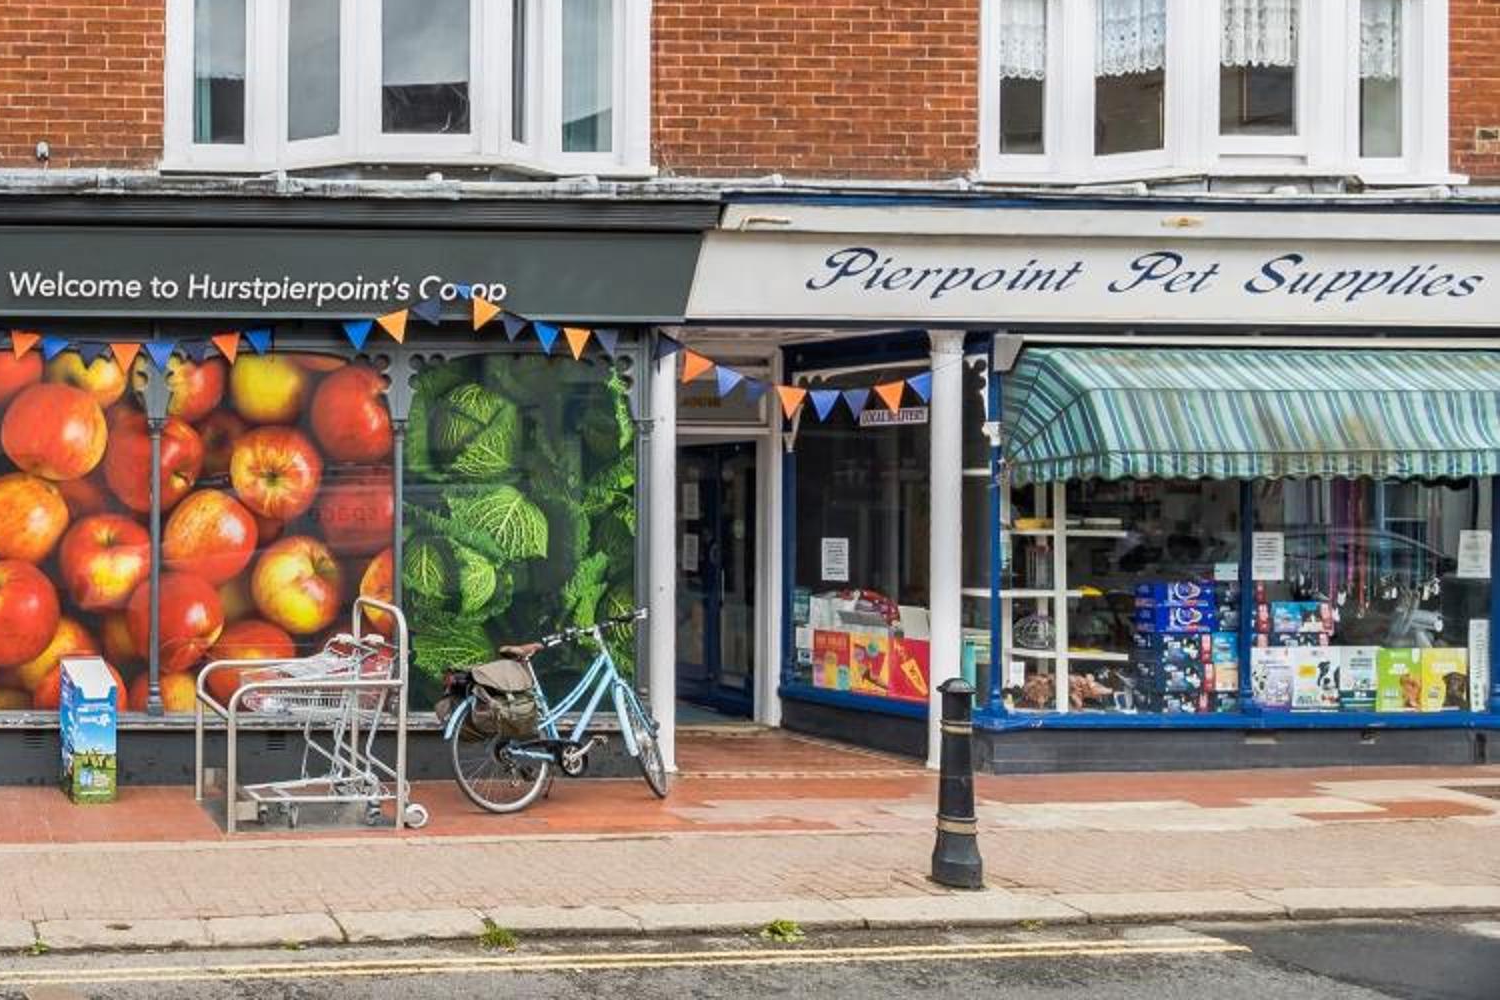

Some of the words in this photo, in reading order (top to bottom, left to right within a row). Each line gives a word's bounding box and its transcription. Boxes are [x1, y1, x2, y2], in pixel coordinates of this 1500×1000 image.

[9, 270, 142, 297] Welcome
[150, 276, 179, 299] to
[188, 273, 411, 306] Hurstpierpoint's
[418, 275, 507, 304] Coop
[805, 247, 1083, 299] Pierpoint
[1108, 251, 1220, 293] Pet
[1244, 253, 1484, 302] Supplies
